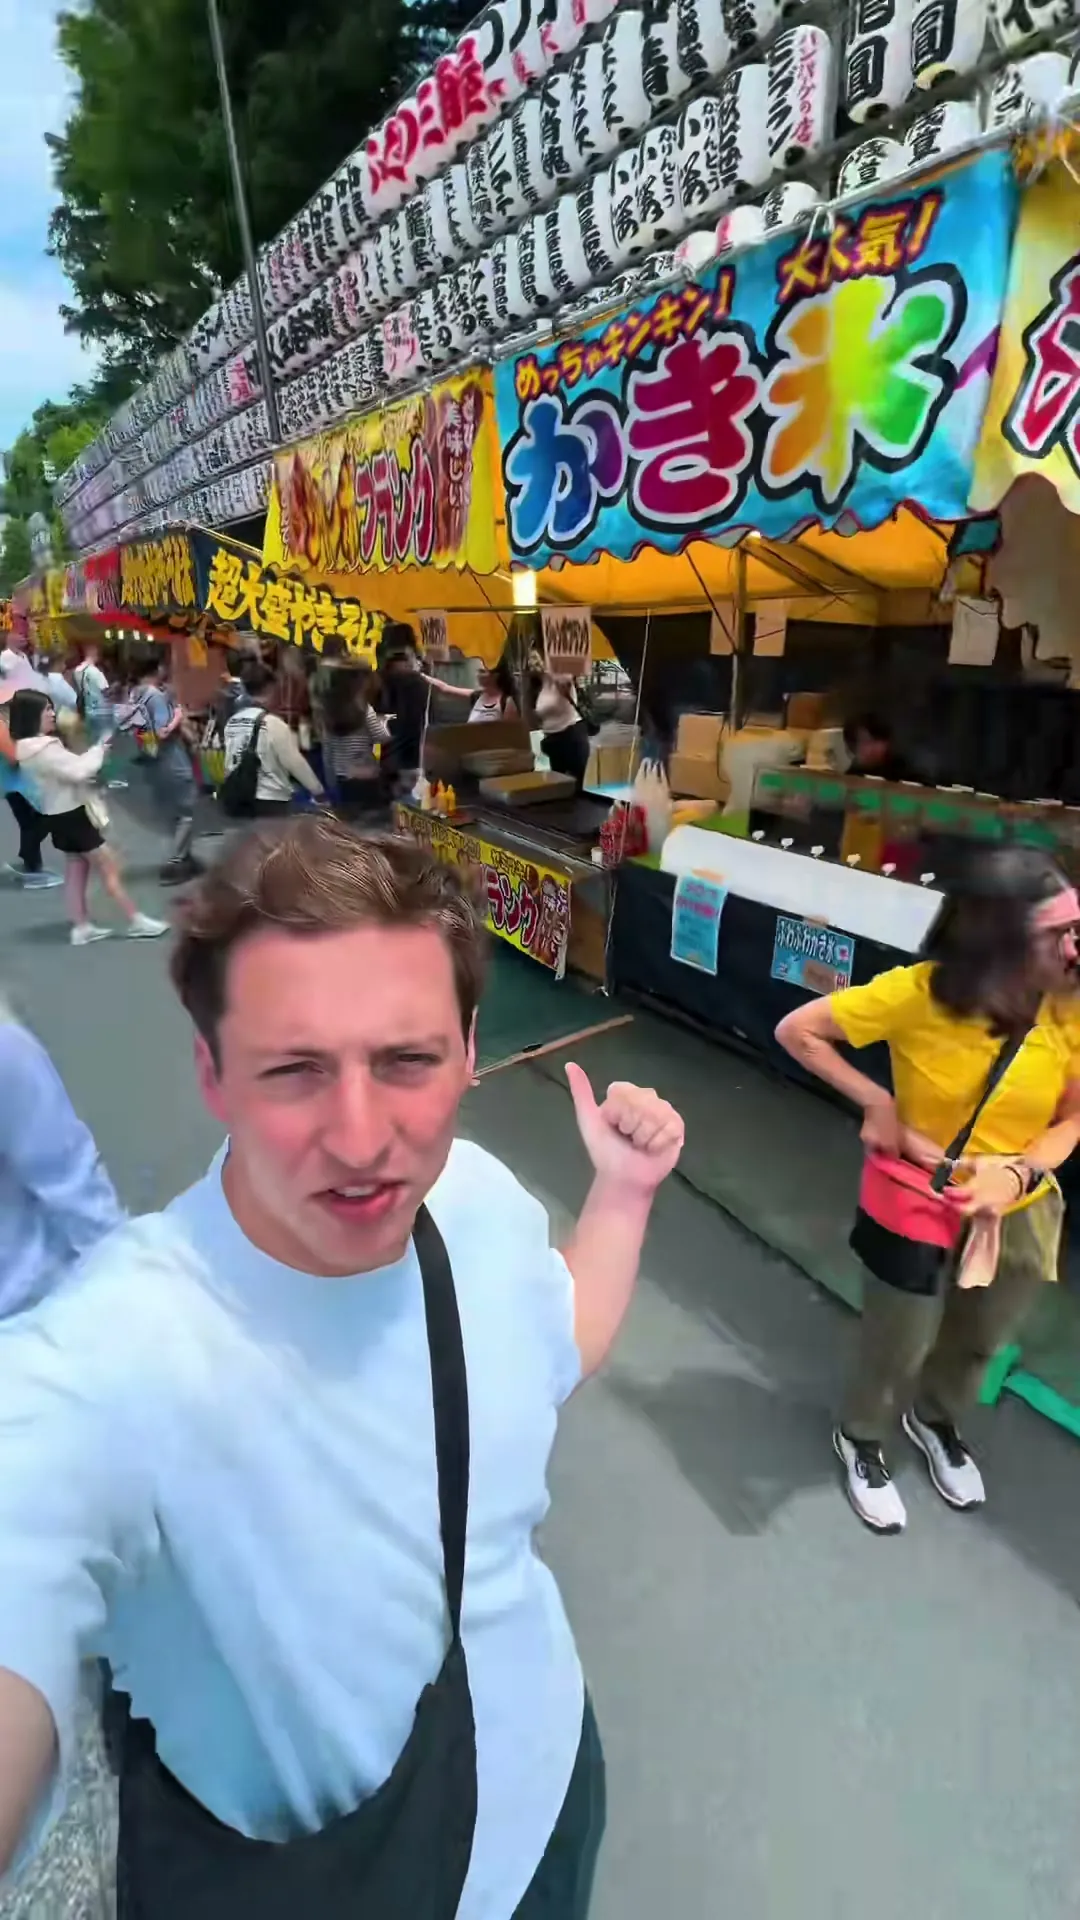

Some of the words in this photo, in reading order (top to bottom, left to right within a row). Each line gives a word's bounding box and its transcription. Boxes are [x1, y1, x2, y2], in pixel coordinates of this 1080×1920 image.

[658, 128, 677, 208] かりんとう
[514, 266, 735, 401] めっちゃキンキン！
[505, 265, 965, 553] かき氷
